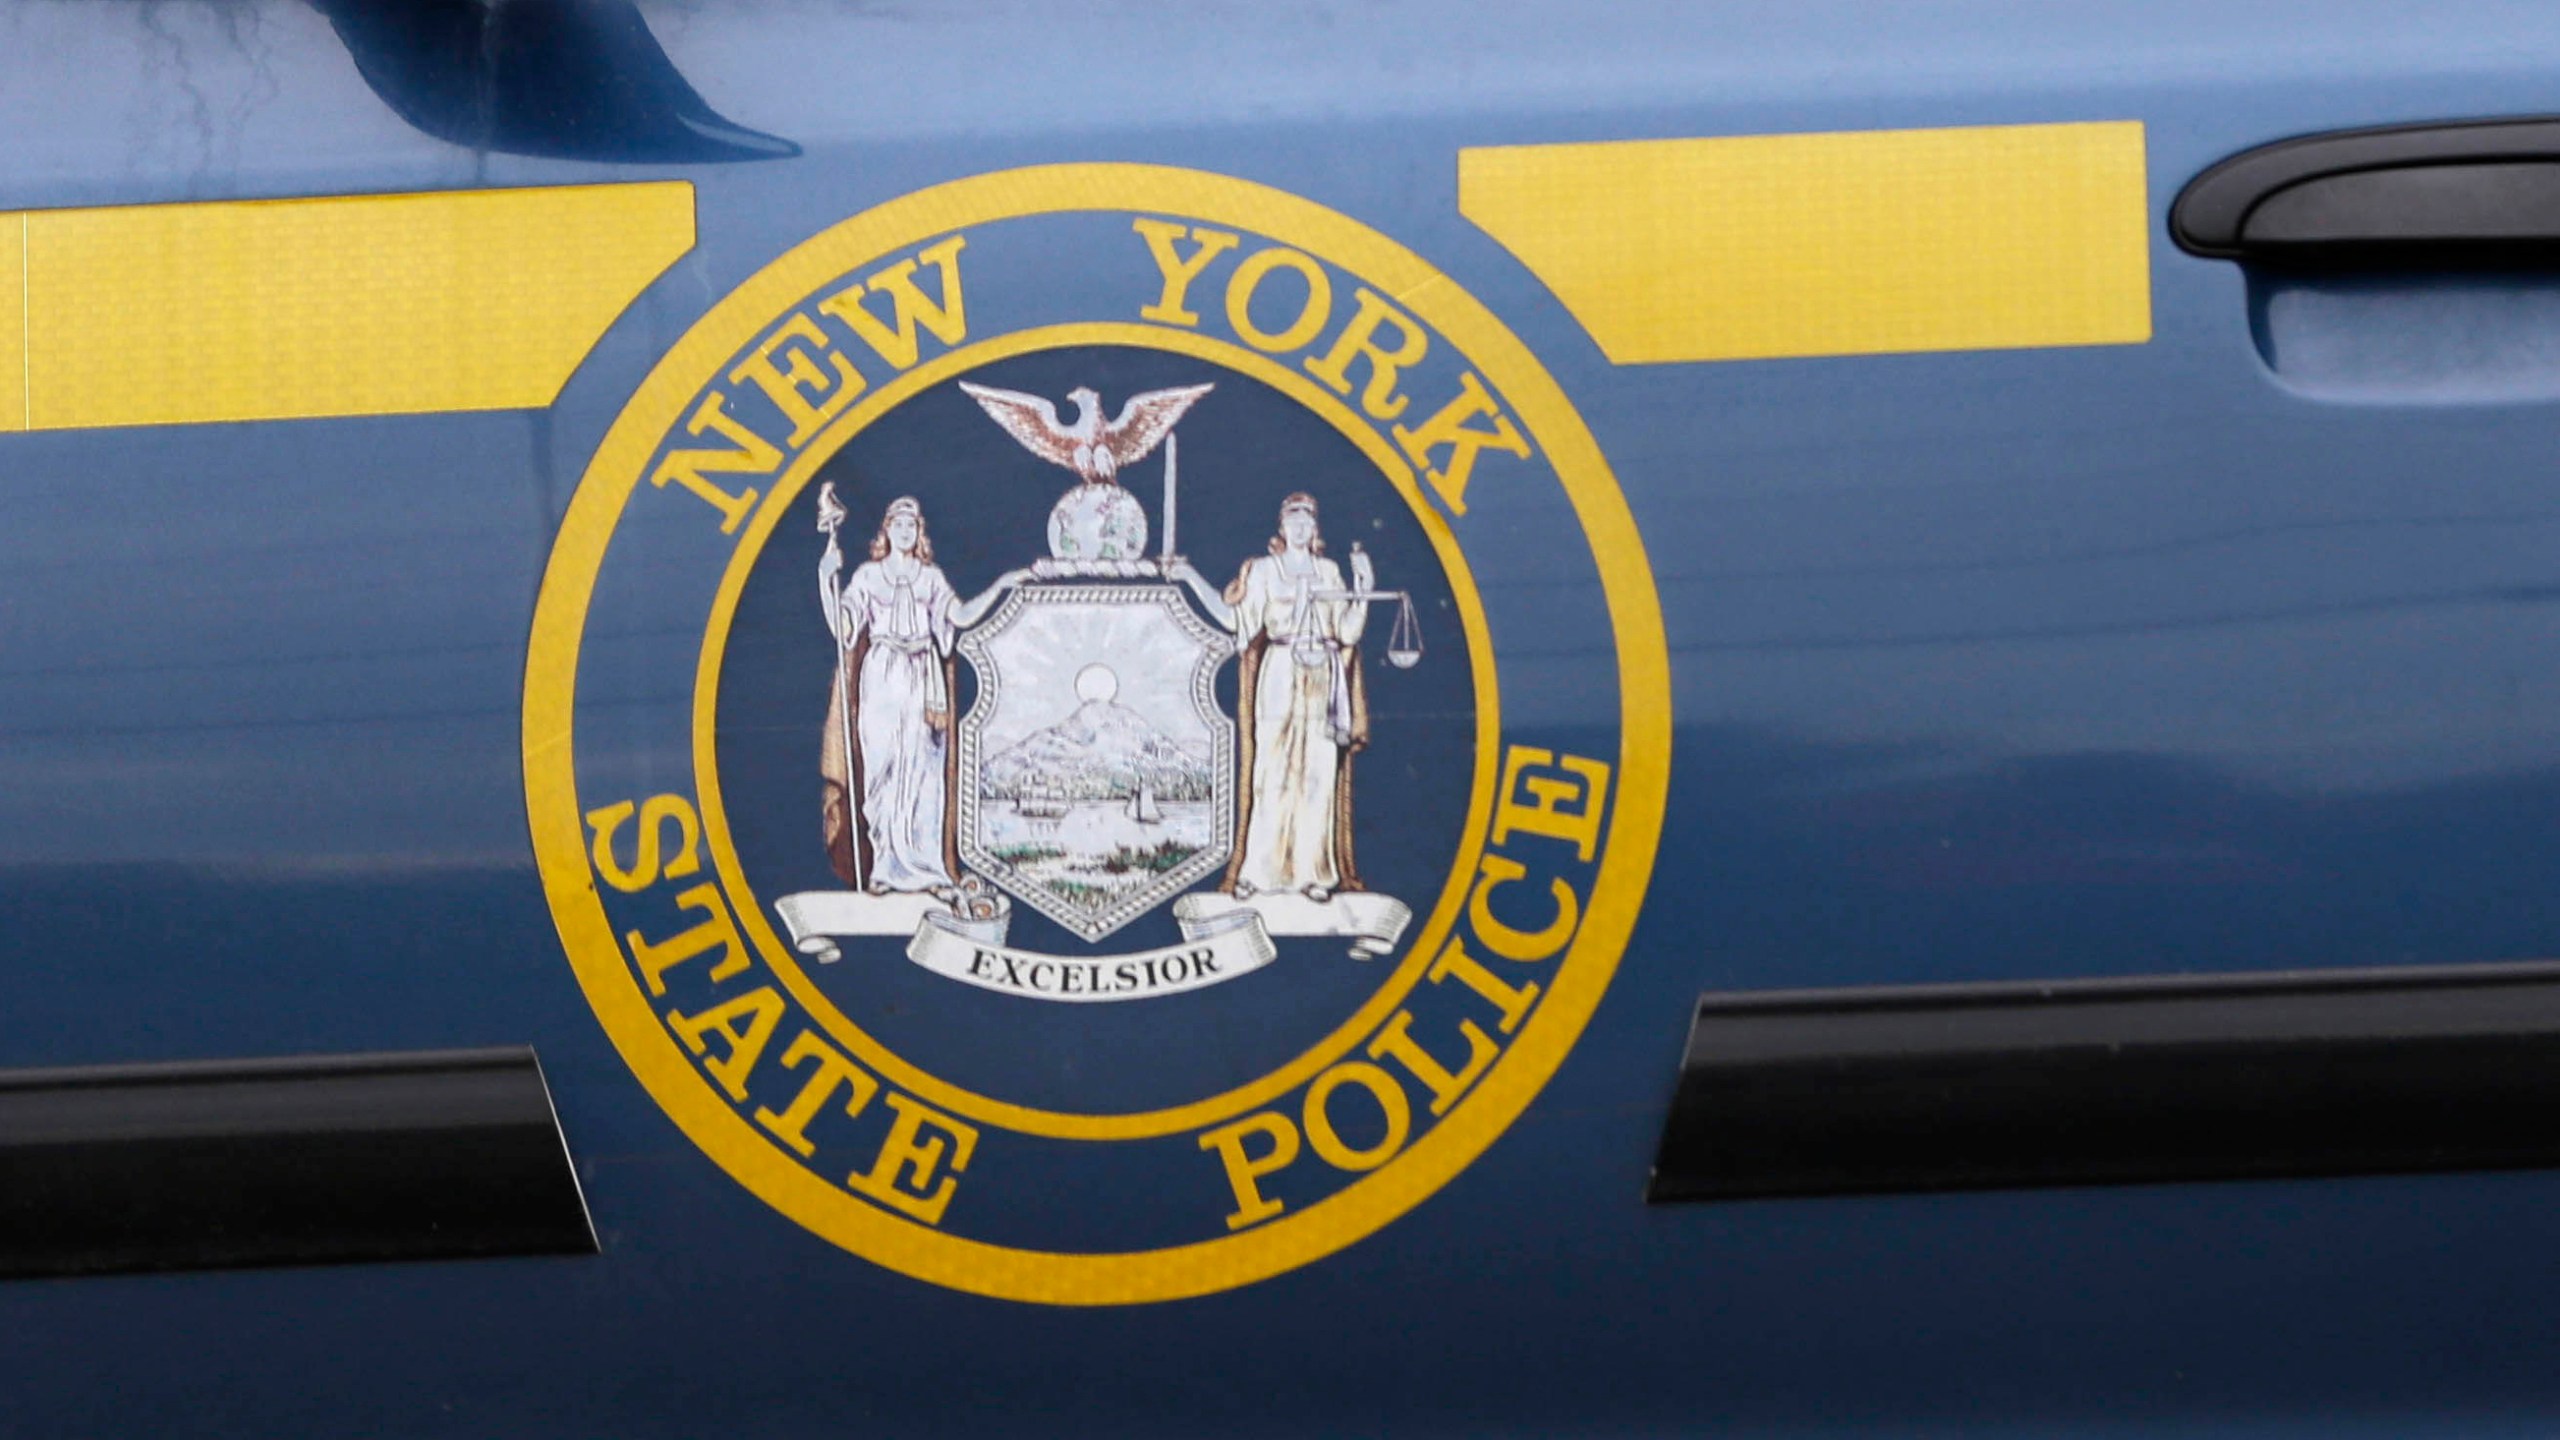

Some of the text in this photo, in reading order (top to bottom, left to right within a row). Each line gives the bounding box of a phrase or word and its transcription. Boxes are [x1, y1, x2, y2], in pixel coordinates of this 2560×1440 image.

[652, 217, 1531, 534] NEW YORK
[586, 746, 1612, 1231] STATE POLICE
[967, 948, 1221, 994] EXCELSIOR
